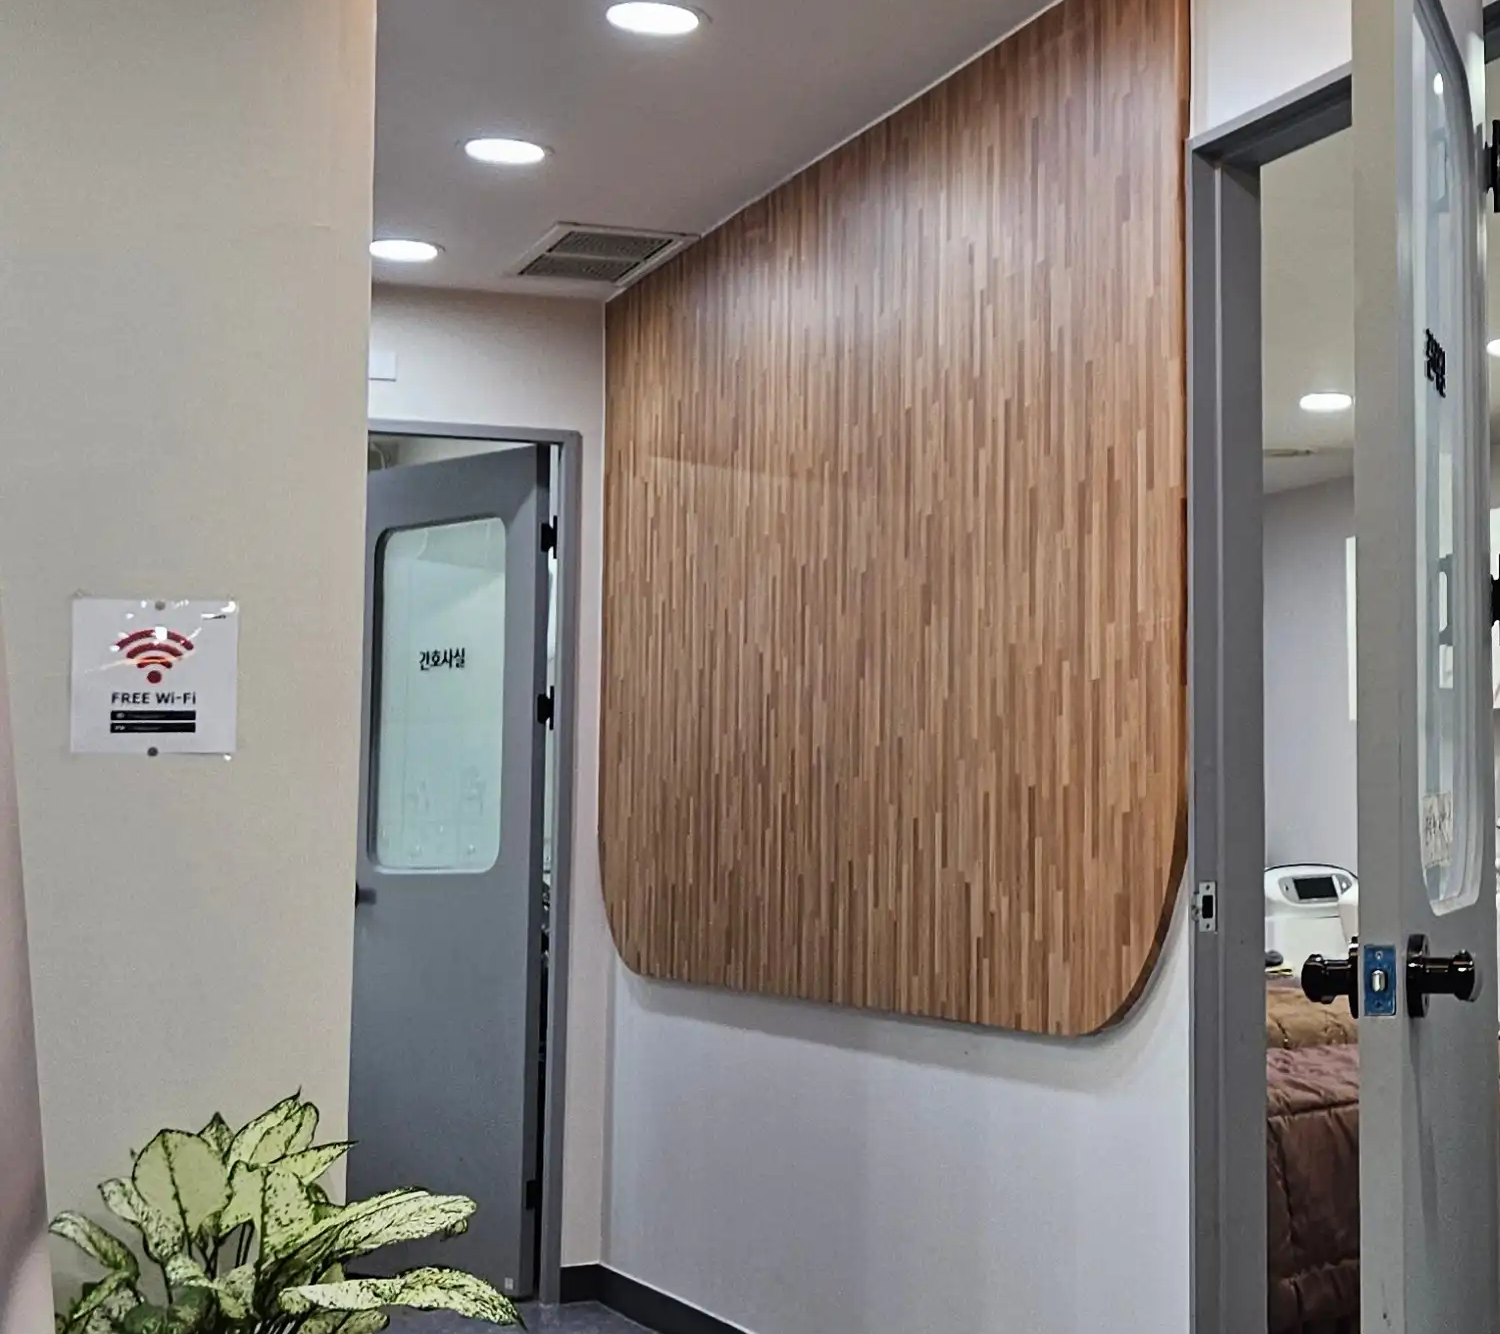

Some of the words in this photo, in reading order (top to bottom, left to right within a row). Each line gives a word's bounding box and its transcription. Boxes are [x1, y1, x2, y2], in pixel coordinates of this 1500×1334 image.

[419, 647, 467, 671] 간호사실
[111, 692, 159, 705] FREE
[165, 692, 197, 705] Wi-Fi
